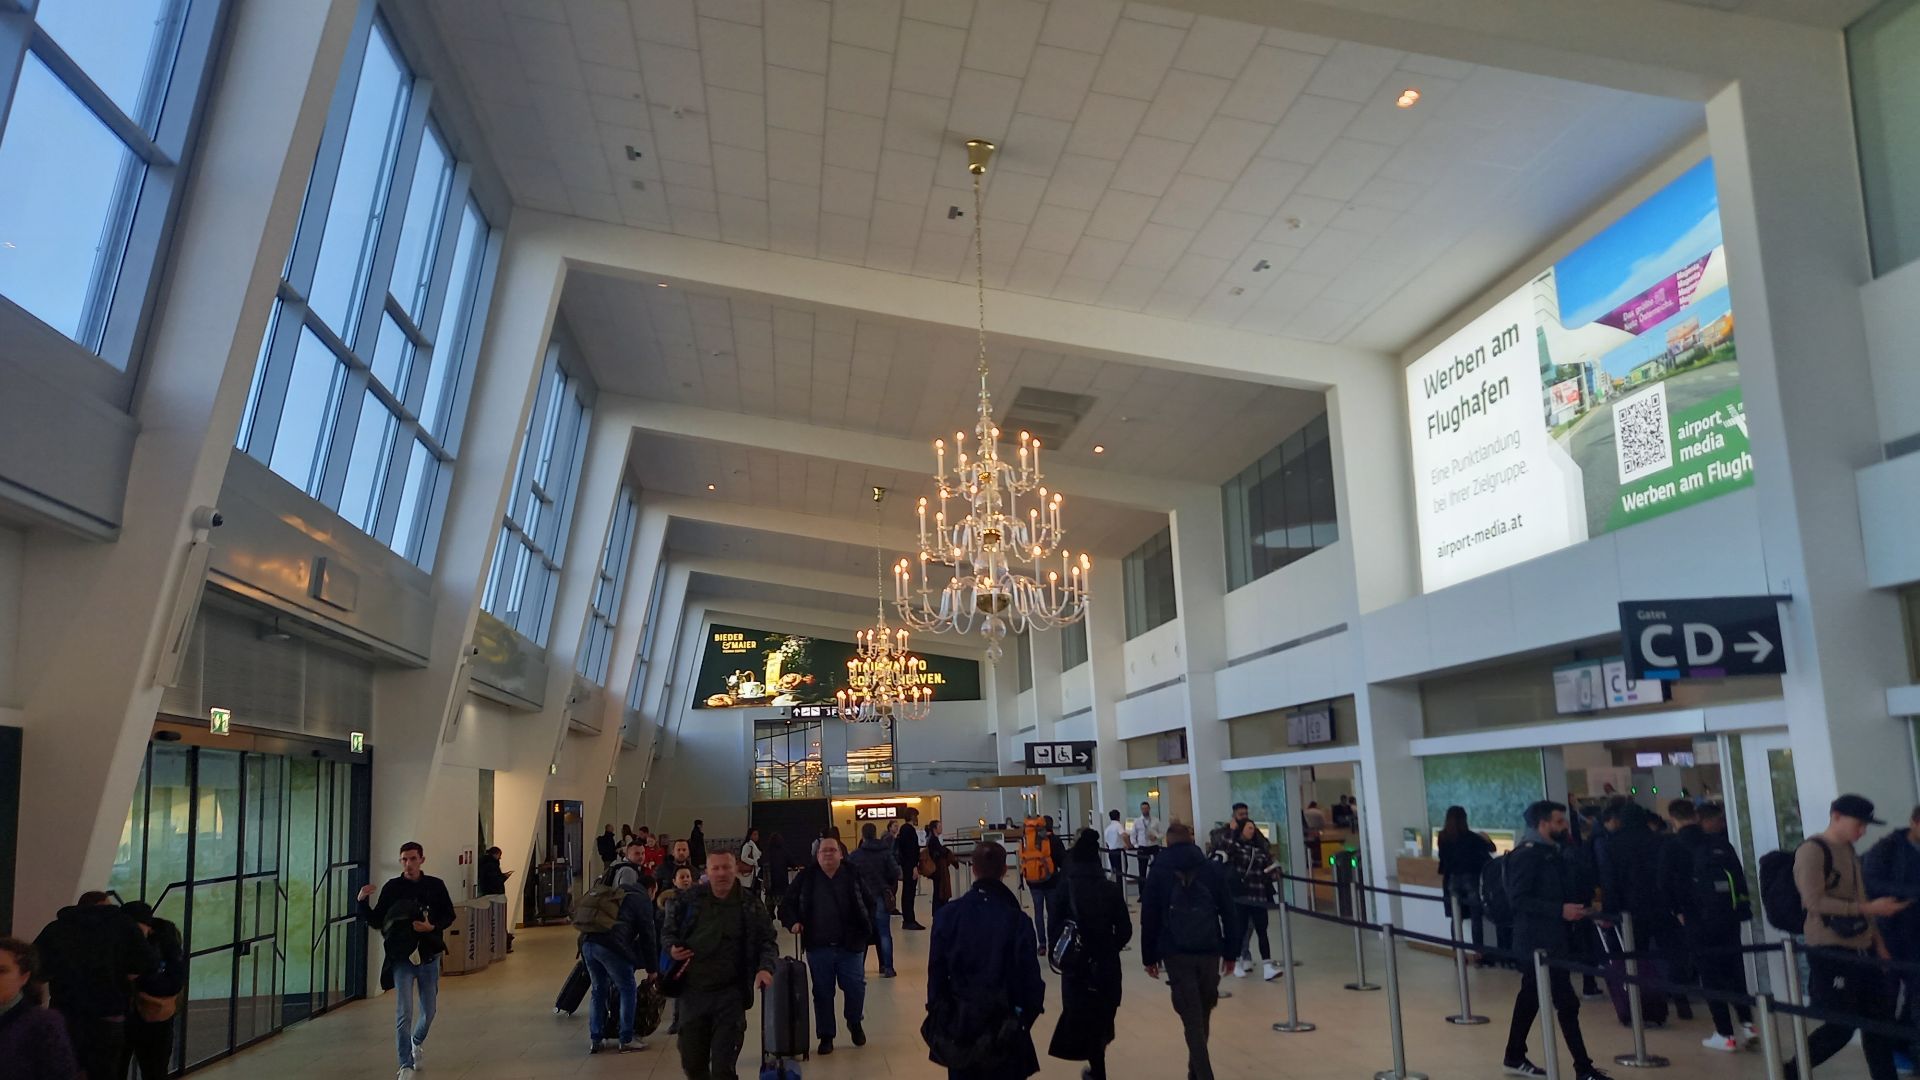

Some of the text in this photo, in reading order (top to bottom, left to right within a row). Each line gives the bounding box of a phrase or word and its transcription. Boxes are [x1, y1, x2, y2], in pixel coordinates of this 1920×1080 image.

[1424, 323, 1520, 399] Werben am
[1427, 376, 1510, 440] Flughafen
[1678, 410, 1723, 439] airport
[1431, 429, 1521, 485] Eine Punktlandung
[1680, 431, 1725, 462] media
[1622, 481, 1676, 513] Werben
[1680, 471, 1704, 494] am
[1437, 512, 1524, 559] airport-media.at
[1637, 609, 1667, 620] Gates
[714, 633, 744, 642] BIEDER
